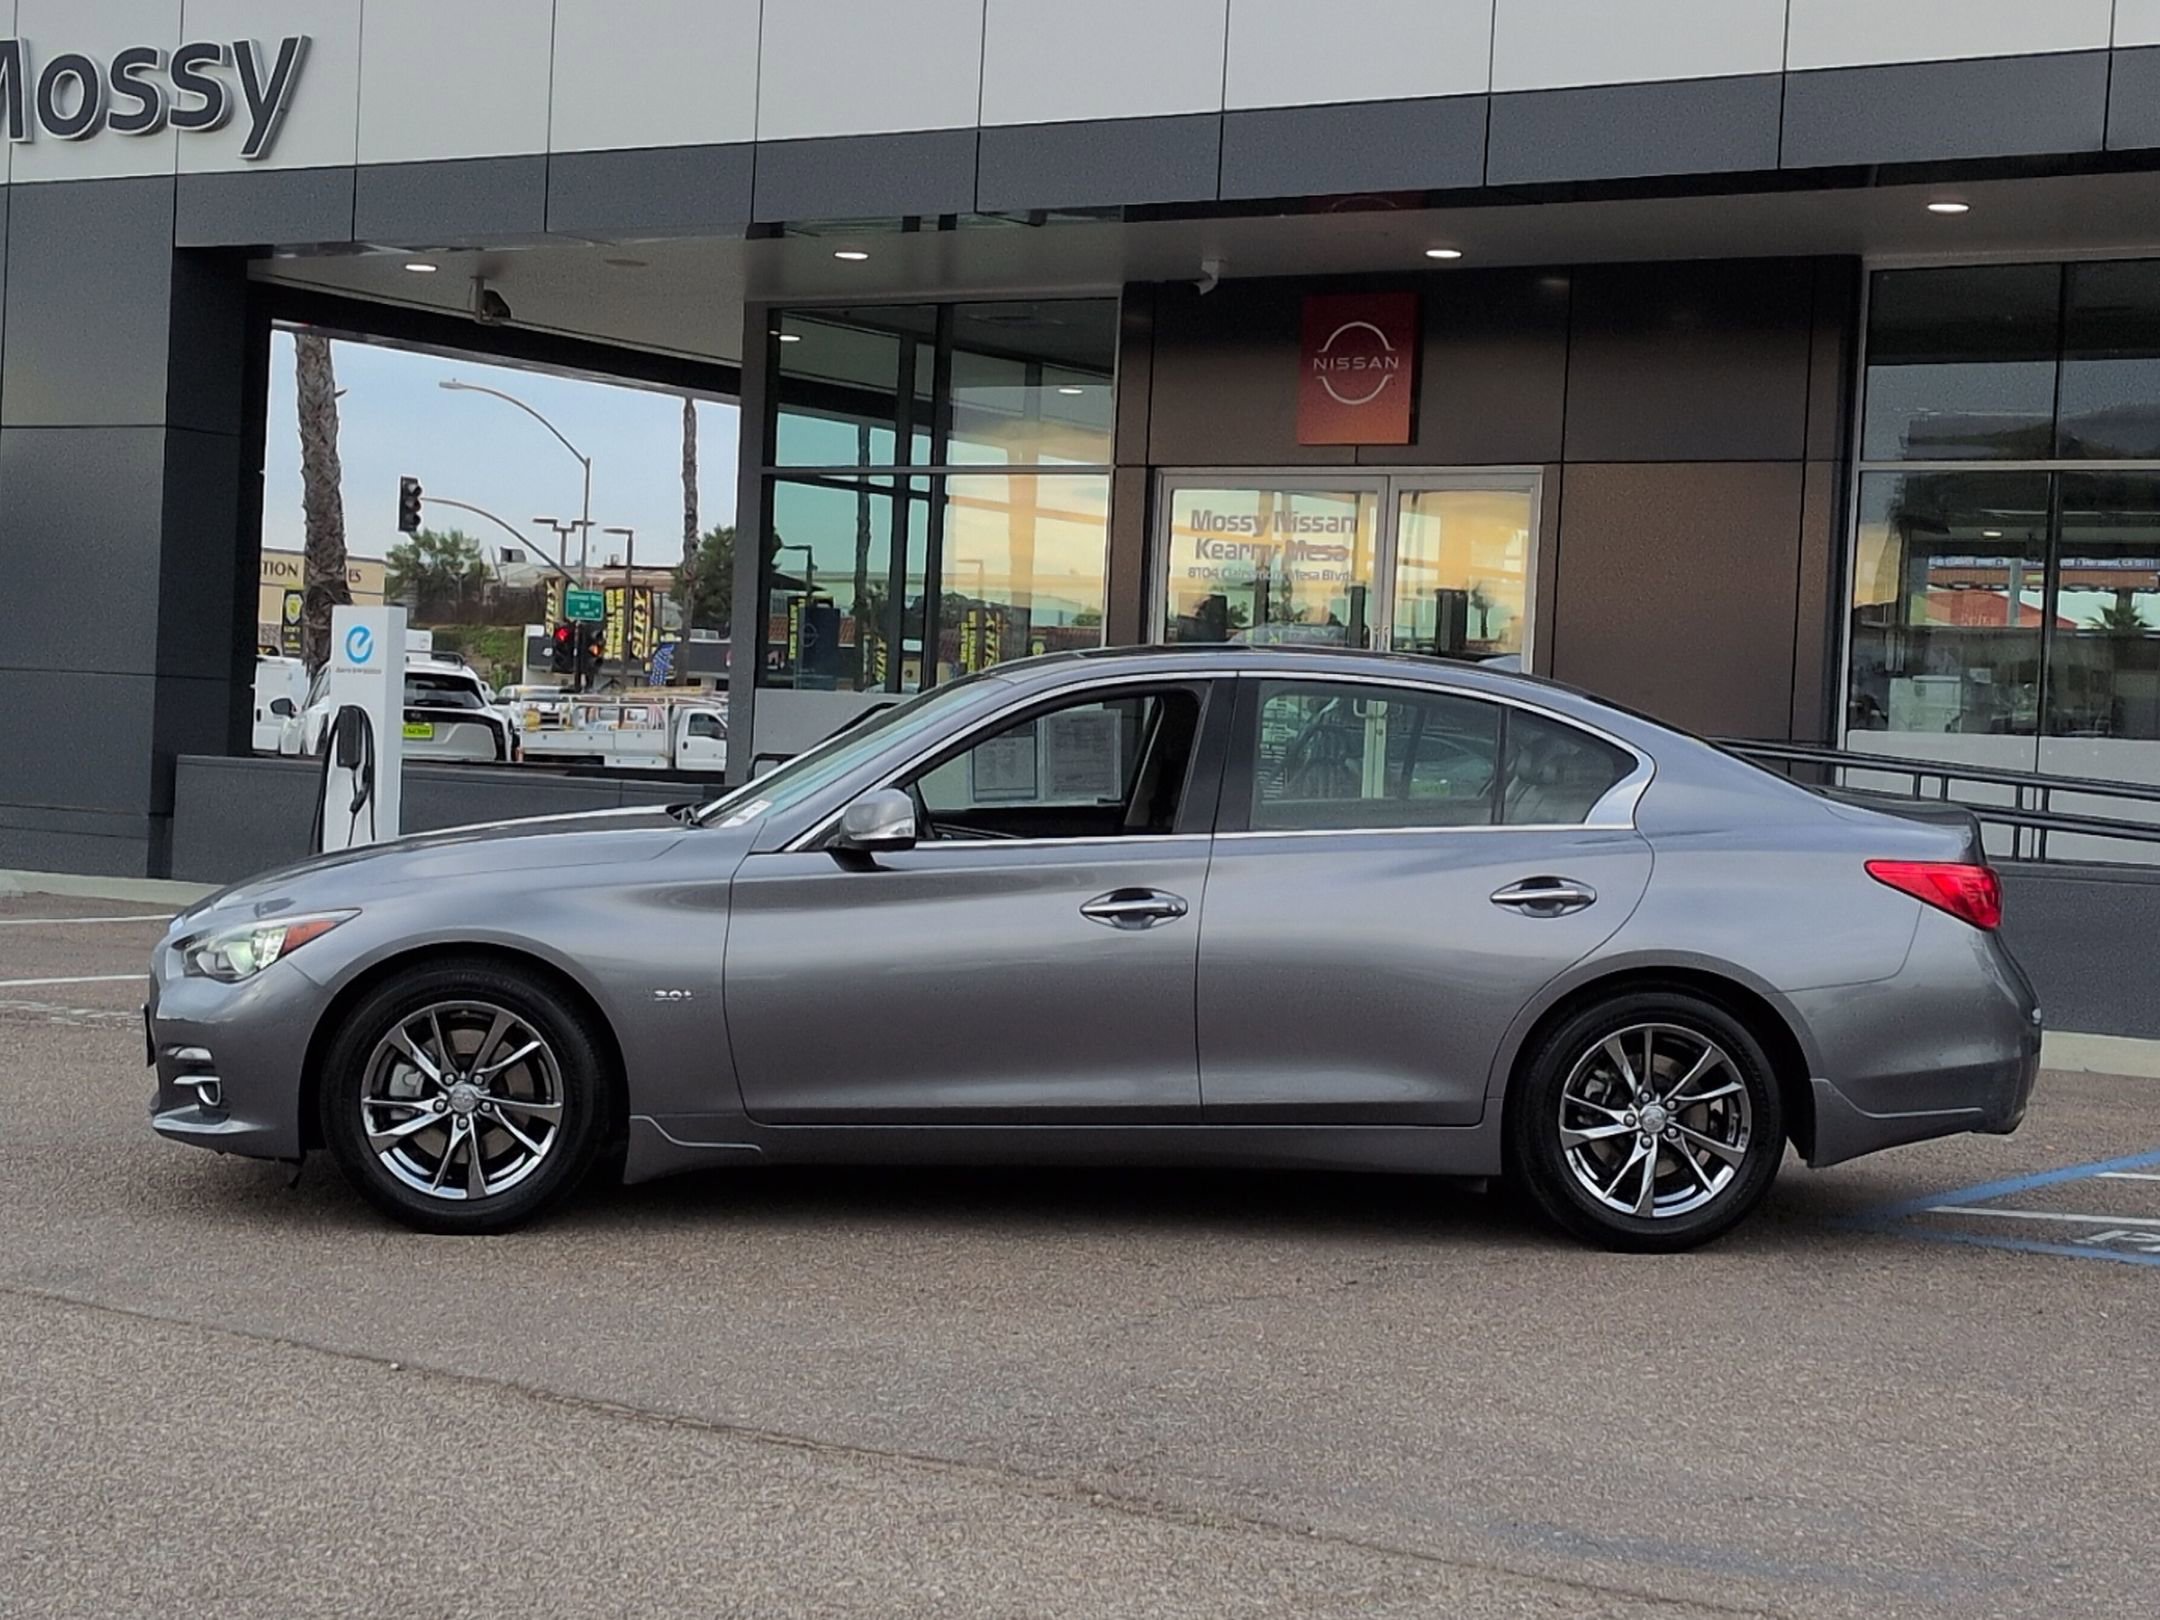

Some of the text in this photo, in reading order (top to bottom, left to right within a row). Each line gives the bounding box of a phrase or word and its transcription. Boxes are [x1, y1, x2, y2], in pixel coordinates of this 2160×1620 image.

[1313, 356, 1399, 371] NISSAN
[1190, 510, 1357, 537] Mossy Nissan
[1285, 539, 1350, 562] Mesa
